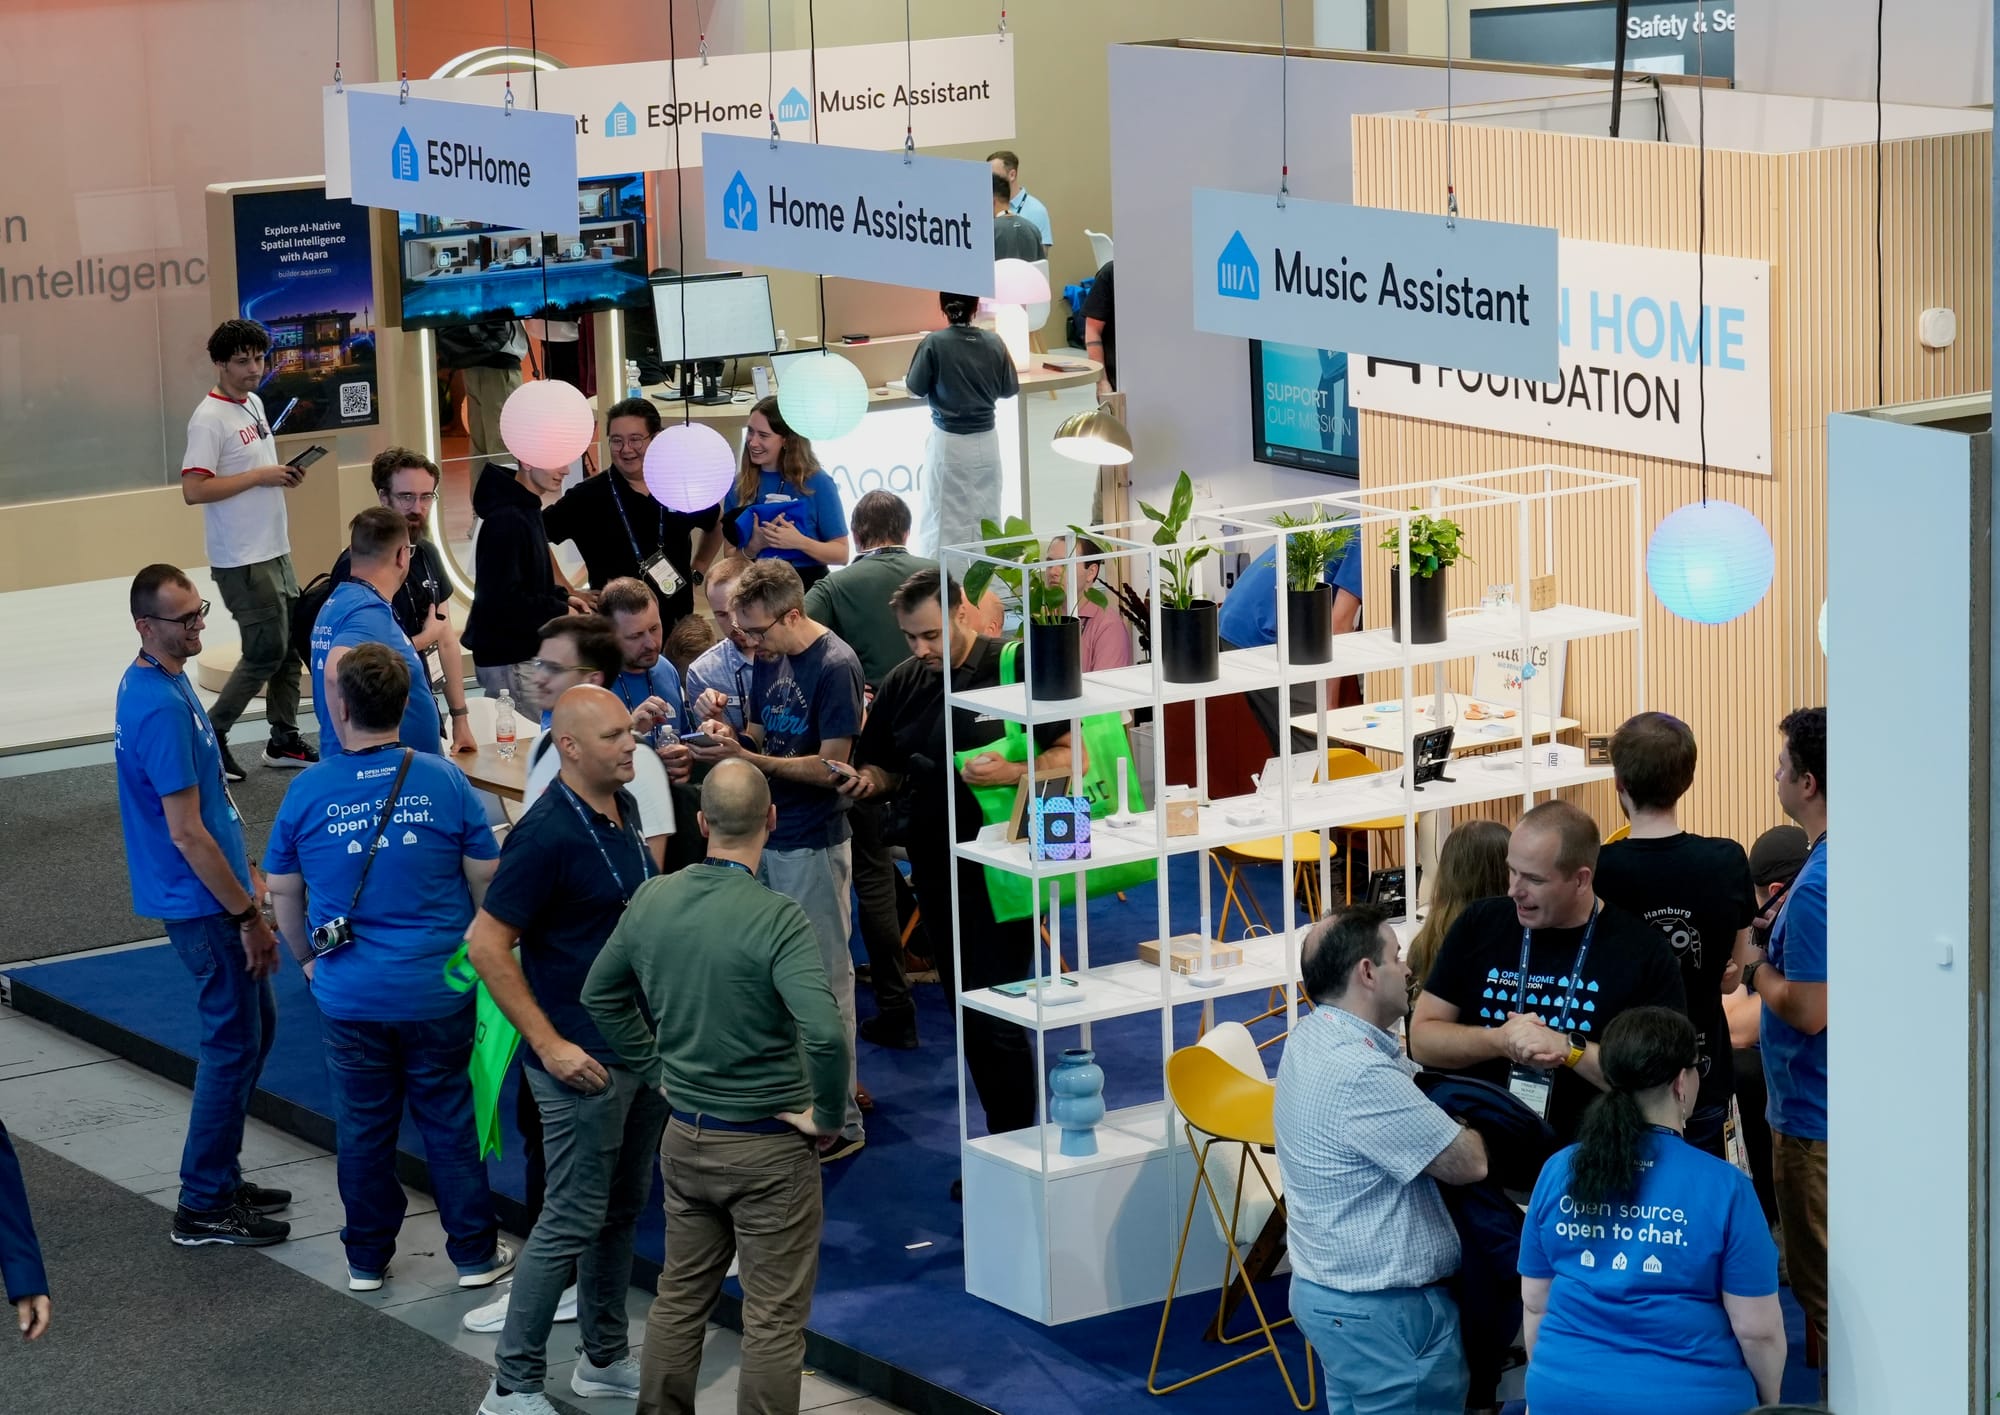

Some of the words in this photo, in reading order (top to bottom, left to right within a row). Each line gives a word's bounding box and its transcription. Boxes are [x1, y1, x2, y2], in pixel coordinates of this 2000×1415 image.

[1626, 14, 1688, 40] Safety
[1692, 11, 1708, 33] &
[647, 101, 762, 128] ESPHome
[820, 87, 885, 113] Music
[893, 79, 990, 107] Assistant
[427, 139, 531, 188] ESPHome
[264, 224, 298, 237] Explore
[299, 221, 341, 233] AI-Native
[769, 184, 845, 233] Home
[852, 195, 972, 250] Assistant
[261, 238, 292, 252] Spatial
[294, 235, 346, 247] Intelligence
[280, 252, 300, 263] with
[302, 250, 329, 261] Aqara
[1274, 247, 1367, 303] Music
[1377, 261, 1530, 326] Assistant
[1589, 290, 1746, 371] HOME
[1266, 382, 1328, 409] SUPPORT
[1267, 405, 1296, 425] OUR
[1299, 410, 1352, 437] MISSION
[326, 802, 371, 819] Open
[375, 795, 433, 810] surce,
[327, 819, 369, 837] open
[393, 809, 434, 824] chat.
[1643, 906, 1692, 920] Hamburg
[1499, 978, 1544, 990] FOUNTION
[1528, 975, 1556, 985] HOME
[1559, 1194, 1612, 1219] Open
[1619, 1203, 1689, 1226] source,
[1555, 1221, 1605, 1241] open
[1612, 1223, 1634, 1241] to
[1638, 1223, 1689, 1248] chat.
